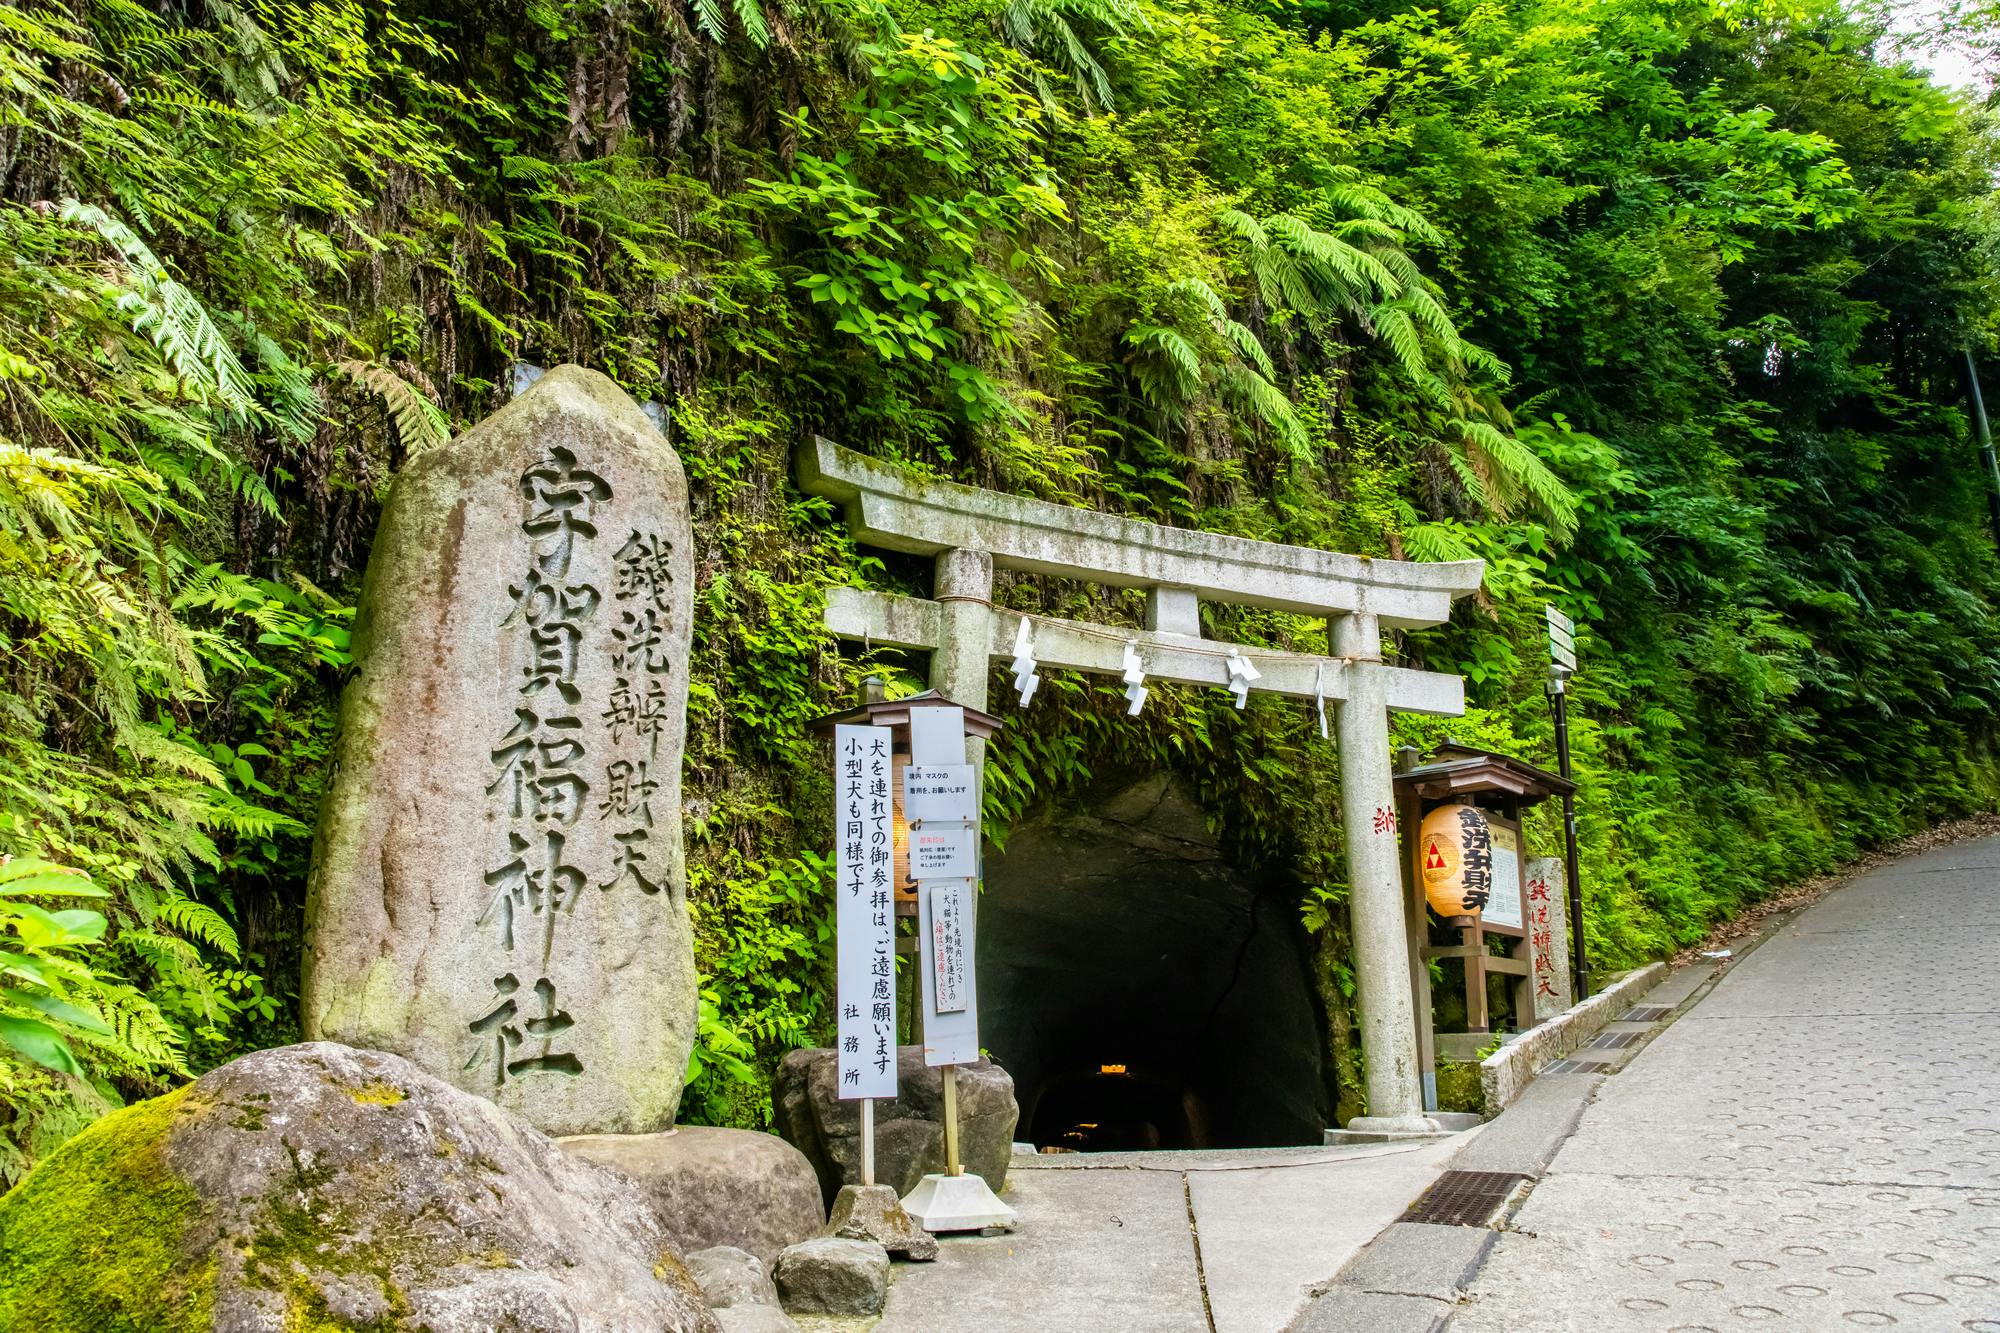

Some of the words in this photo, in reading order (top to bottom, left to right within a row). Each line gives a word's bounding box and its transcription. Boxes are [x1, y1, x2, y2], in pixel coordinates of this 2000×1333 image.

[464, 445, 614, 1086] 宇賀福神社
[845, 737, 865, 897] 小型犬も同様です
[869, 738, 891, 1075] 犬を連れての御参拝は、ご遠慮願います
